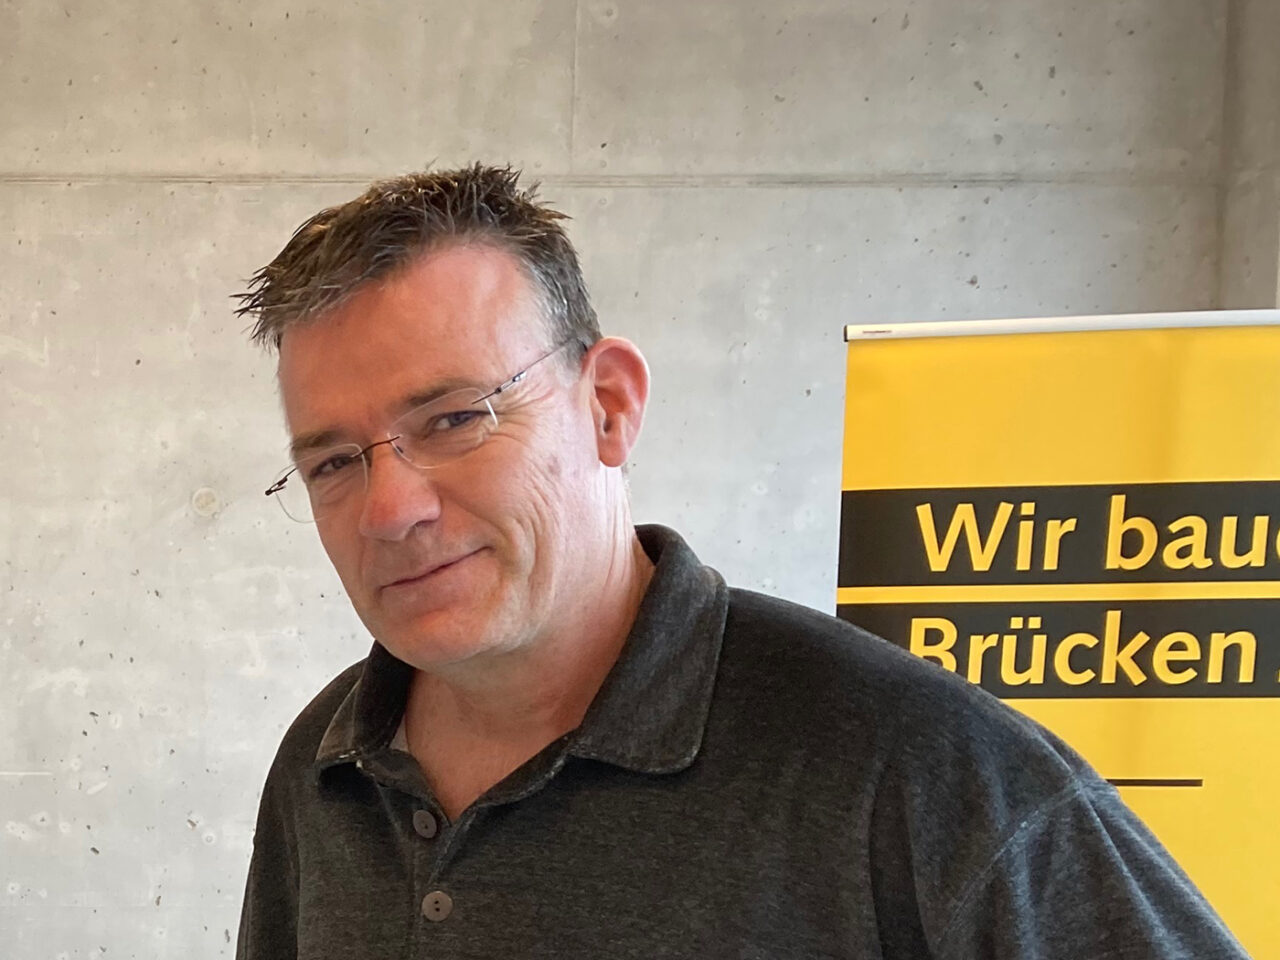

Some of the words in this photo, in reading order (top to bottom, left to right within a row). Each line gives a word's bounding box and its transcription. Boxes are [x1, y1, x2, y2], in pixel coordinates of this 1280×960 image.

[915, 501, 1078, 573] Wir
[1104, 494, 1280, 571] bau
[909, 610, 1258, 687] Brücken
